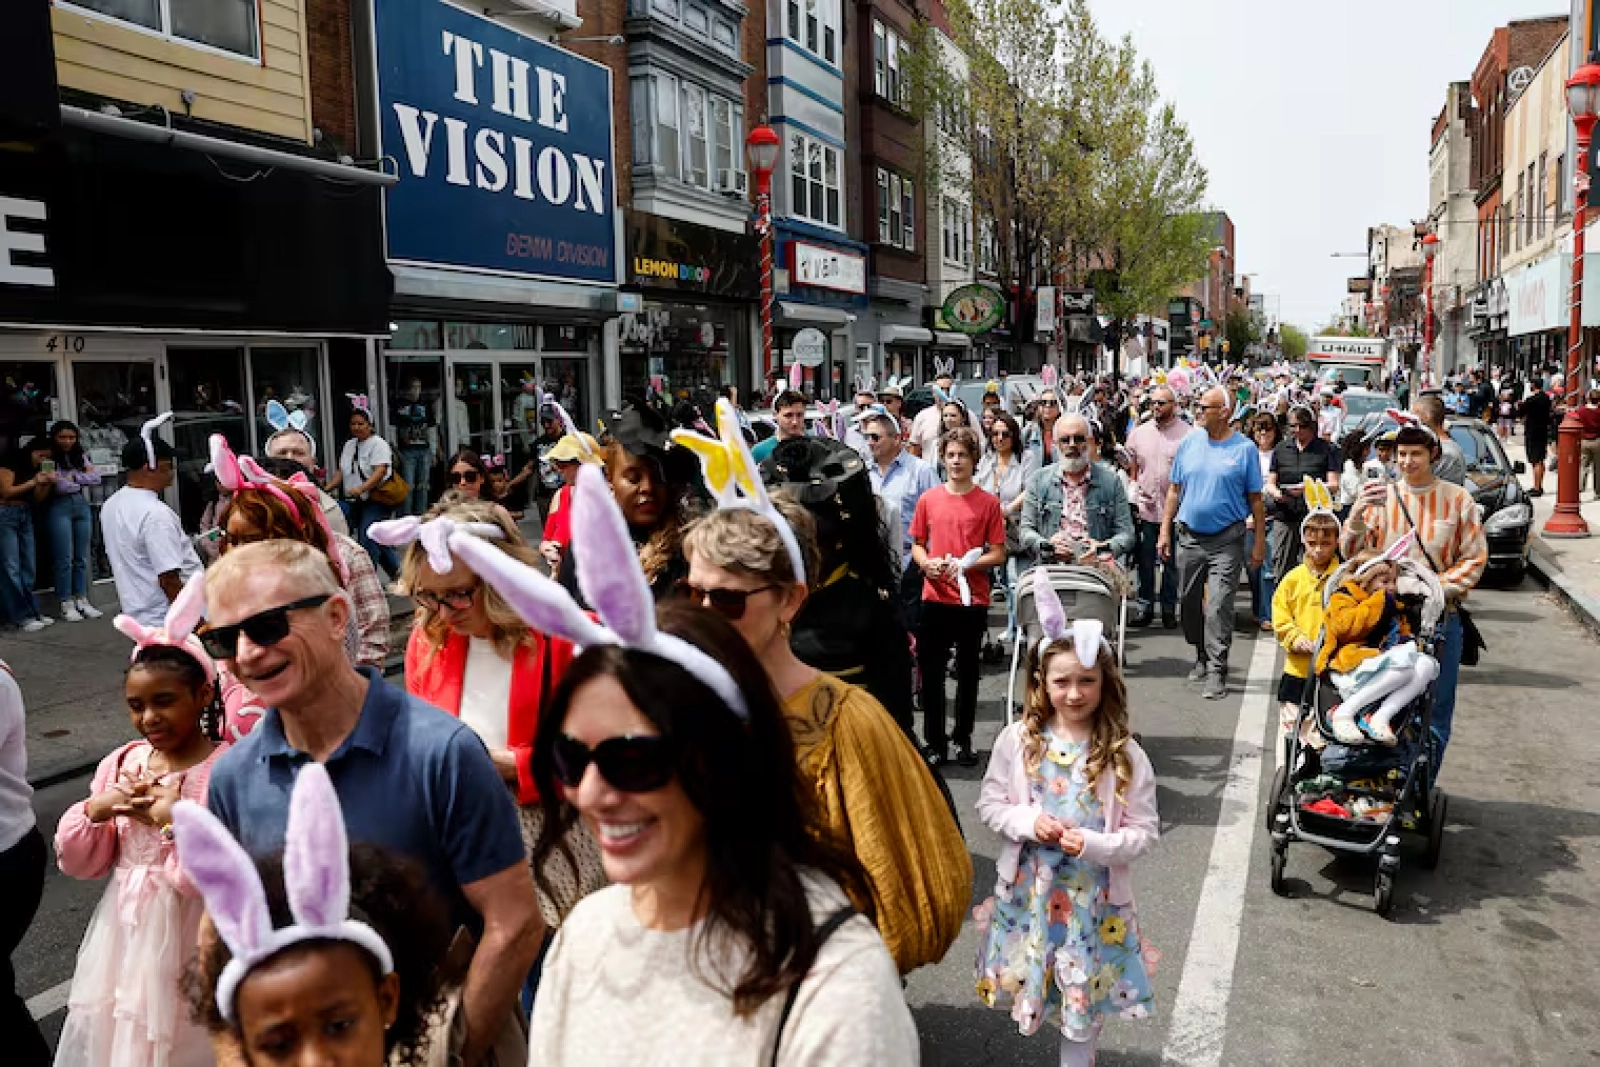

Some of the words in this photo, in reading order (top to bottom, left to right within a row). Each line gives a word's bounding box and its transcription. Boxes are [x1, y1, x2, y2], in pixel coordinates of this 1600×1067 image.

[442, 30, 569, 133] THE
[393, 102, 605, 215] VISION
[506, 233, 552, 261] DENIM
[557, 241, 607, 267] DIVISION
[634, 256, 679, 279] LEMON
[680, 264, 711, 282] DROP
[46, 335, 85, 353] 410
[1321, 344, 1375, 354] U-HAUL
